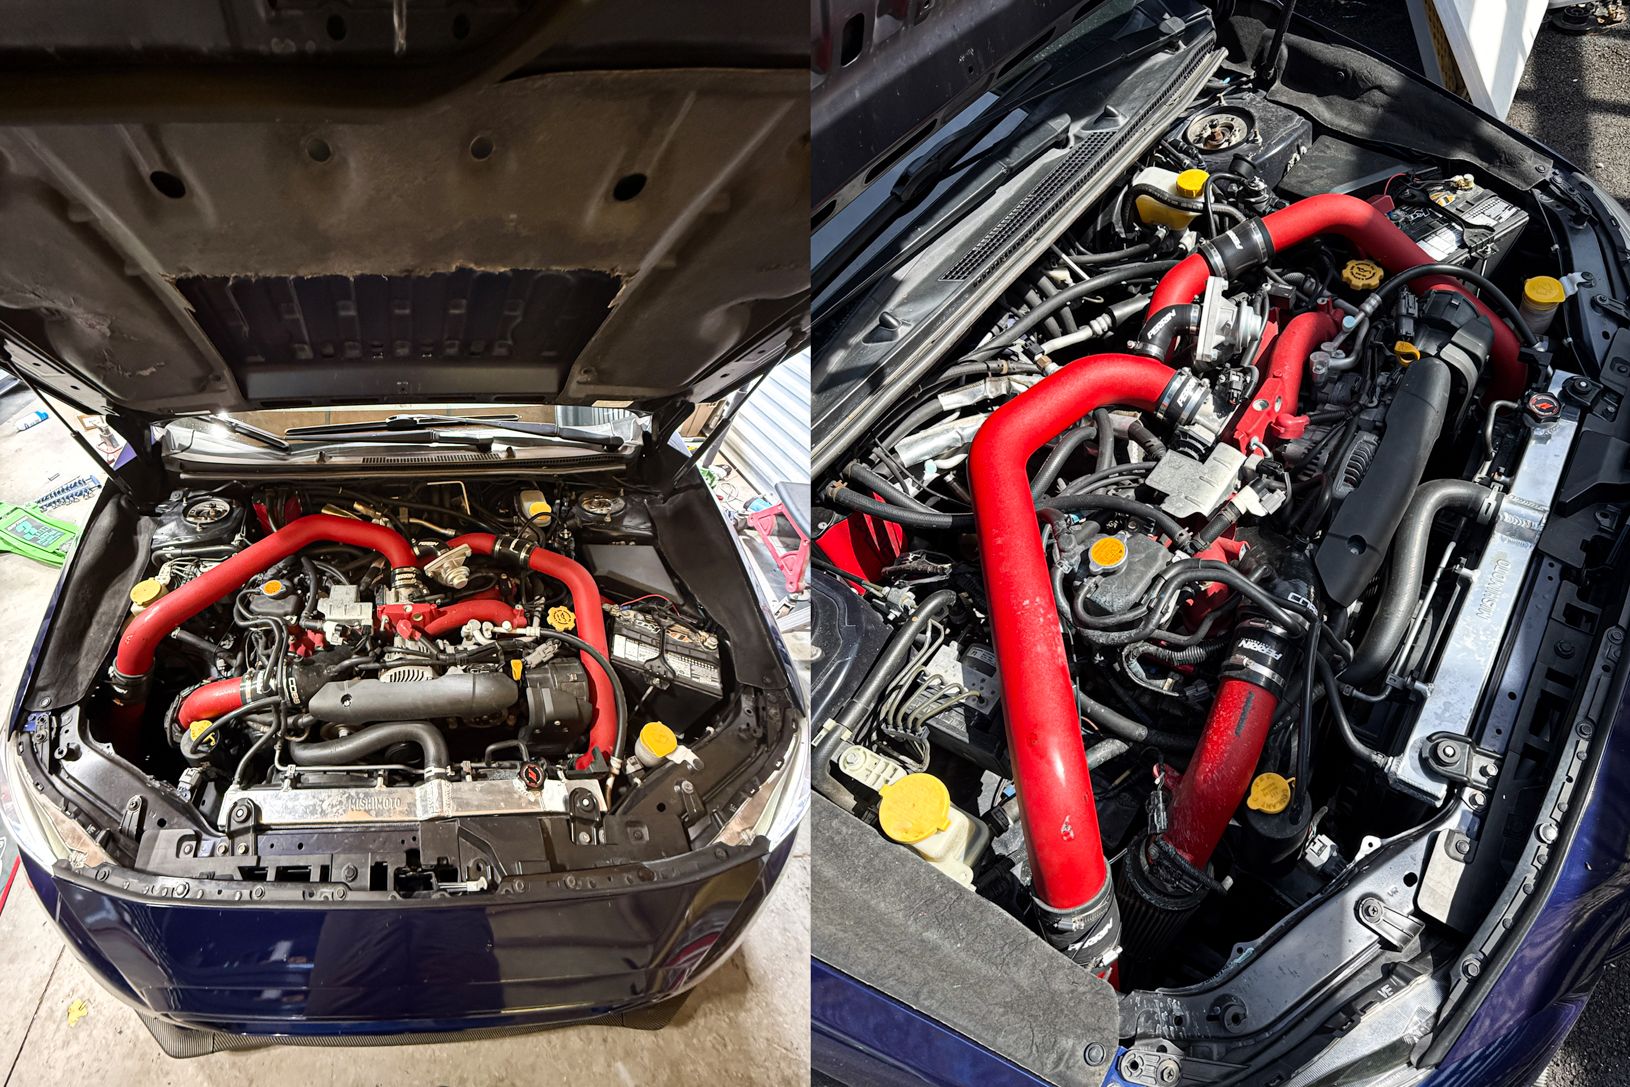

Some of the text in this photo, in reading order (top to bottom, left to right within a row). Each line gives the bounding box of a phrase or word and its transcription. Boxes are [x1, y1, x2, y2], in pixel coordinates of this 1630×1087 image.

[1147, 309, 1176, 340] PERRIN
[1476, 559, 1511, 620] MISHIMOTO
[1238, 639, 1283, 660] PERRIN
[348, 796, 401, 810] MISHIMOTO
